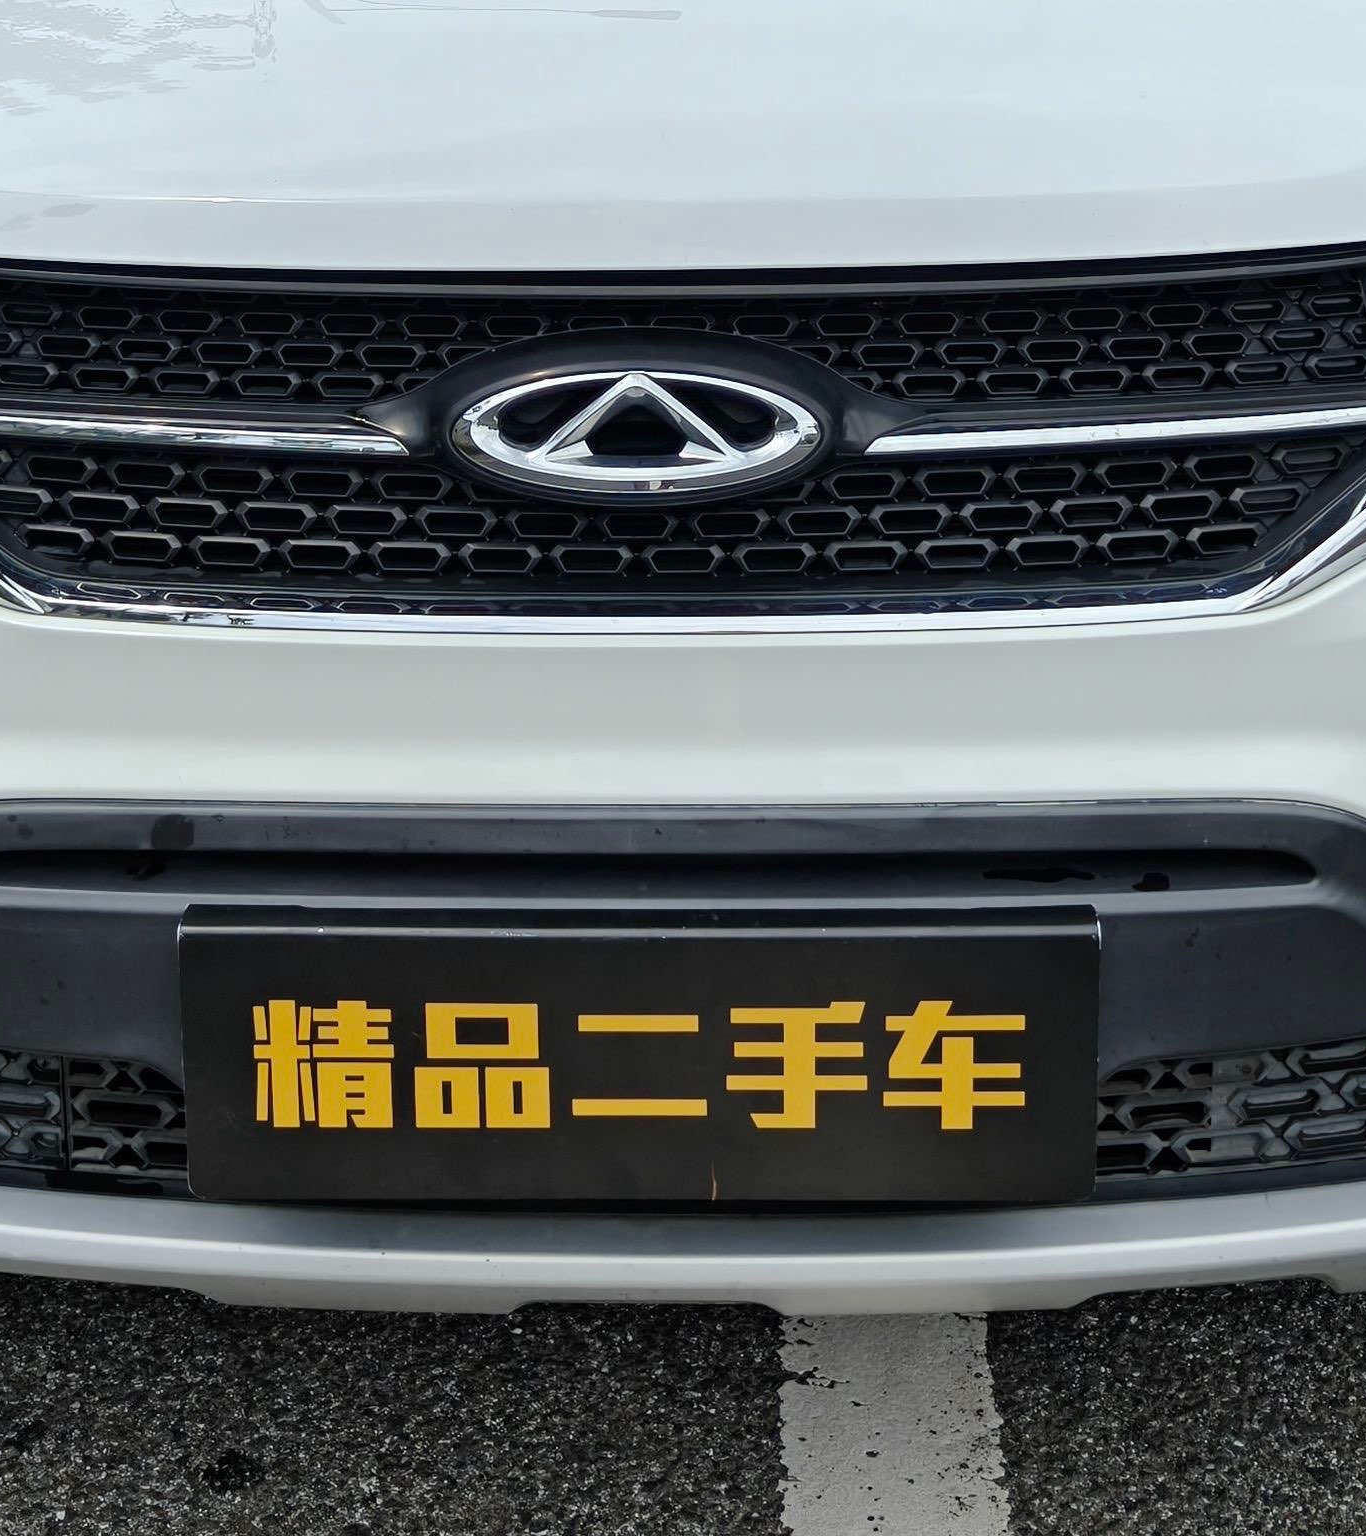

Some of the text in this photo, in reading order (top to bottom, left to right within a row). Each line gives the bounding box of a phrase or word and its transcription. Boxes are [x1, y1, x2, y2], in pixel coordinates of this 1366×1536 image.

[252, 999, 1026, 1130] 精品二手车
